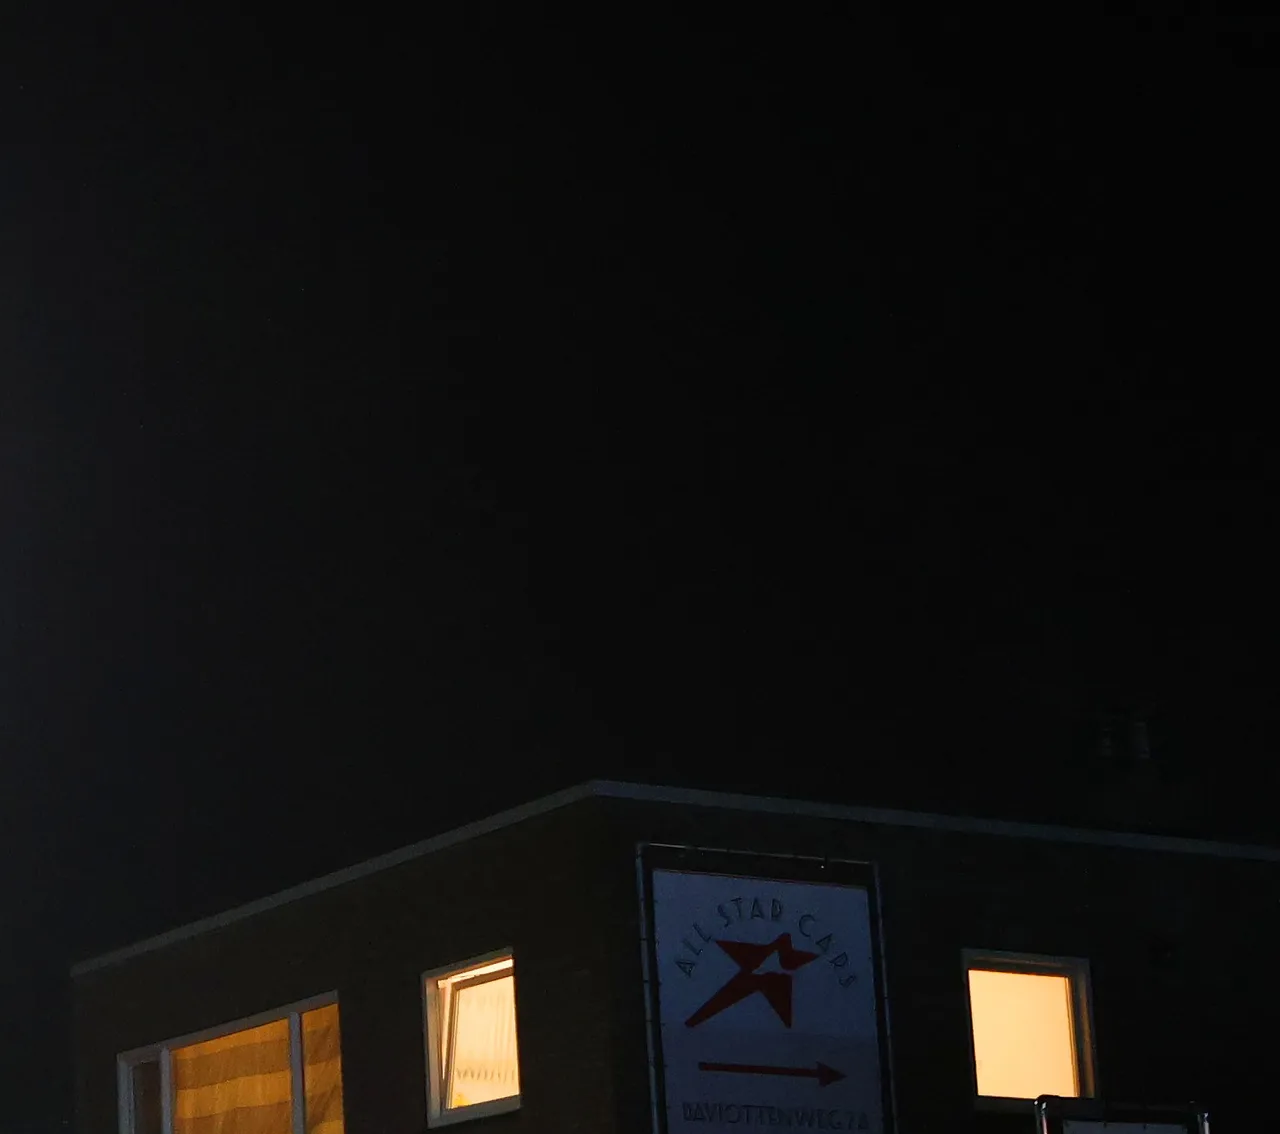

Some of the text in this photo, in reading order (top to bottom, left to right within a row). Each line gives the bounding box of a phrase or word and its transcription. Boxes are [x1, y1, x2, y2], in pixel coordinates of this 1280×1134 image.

[675, 897, 858, 988] ALL STAR CARS
